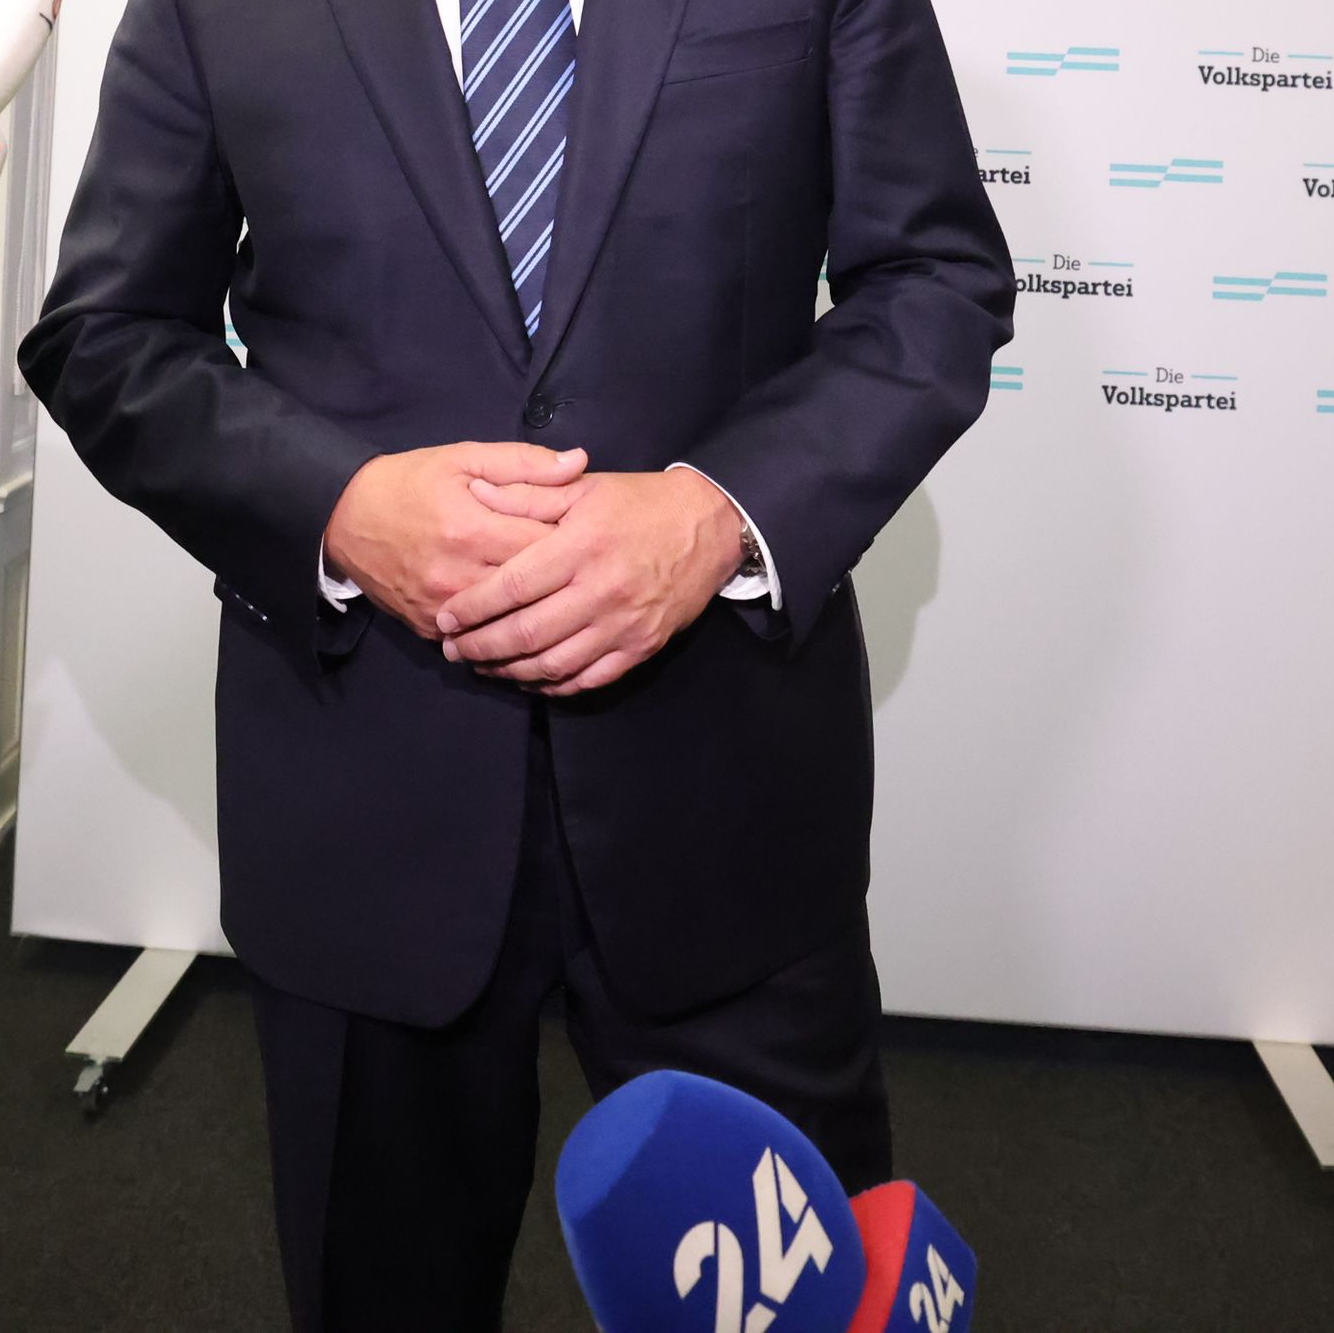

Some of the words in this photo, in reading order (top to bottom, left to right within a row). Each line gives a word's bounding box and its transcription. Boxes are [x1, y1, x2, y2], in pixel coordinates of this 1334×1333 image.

[1252, 46, 1280, 64] Die
[1198, 66, 1333, 91] Volkspartei
[1053, 254, 1081, 271] Die
[1016, 273, 1133, 299] olkspartei
[1155, 367, 1184, 384] Die
[1101, 385, 1237, 412] Volkspartei
[673, 1146, 834, 1333] 24
[909, 1244, 964, 1333] 24
